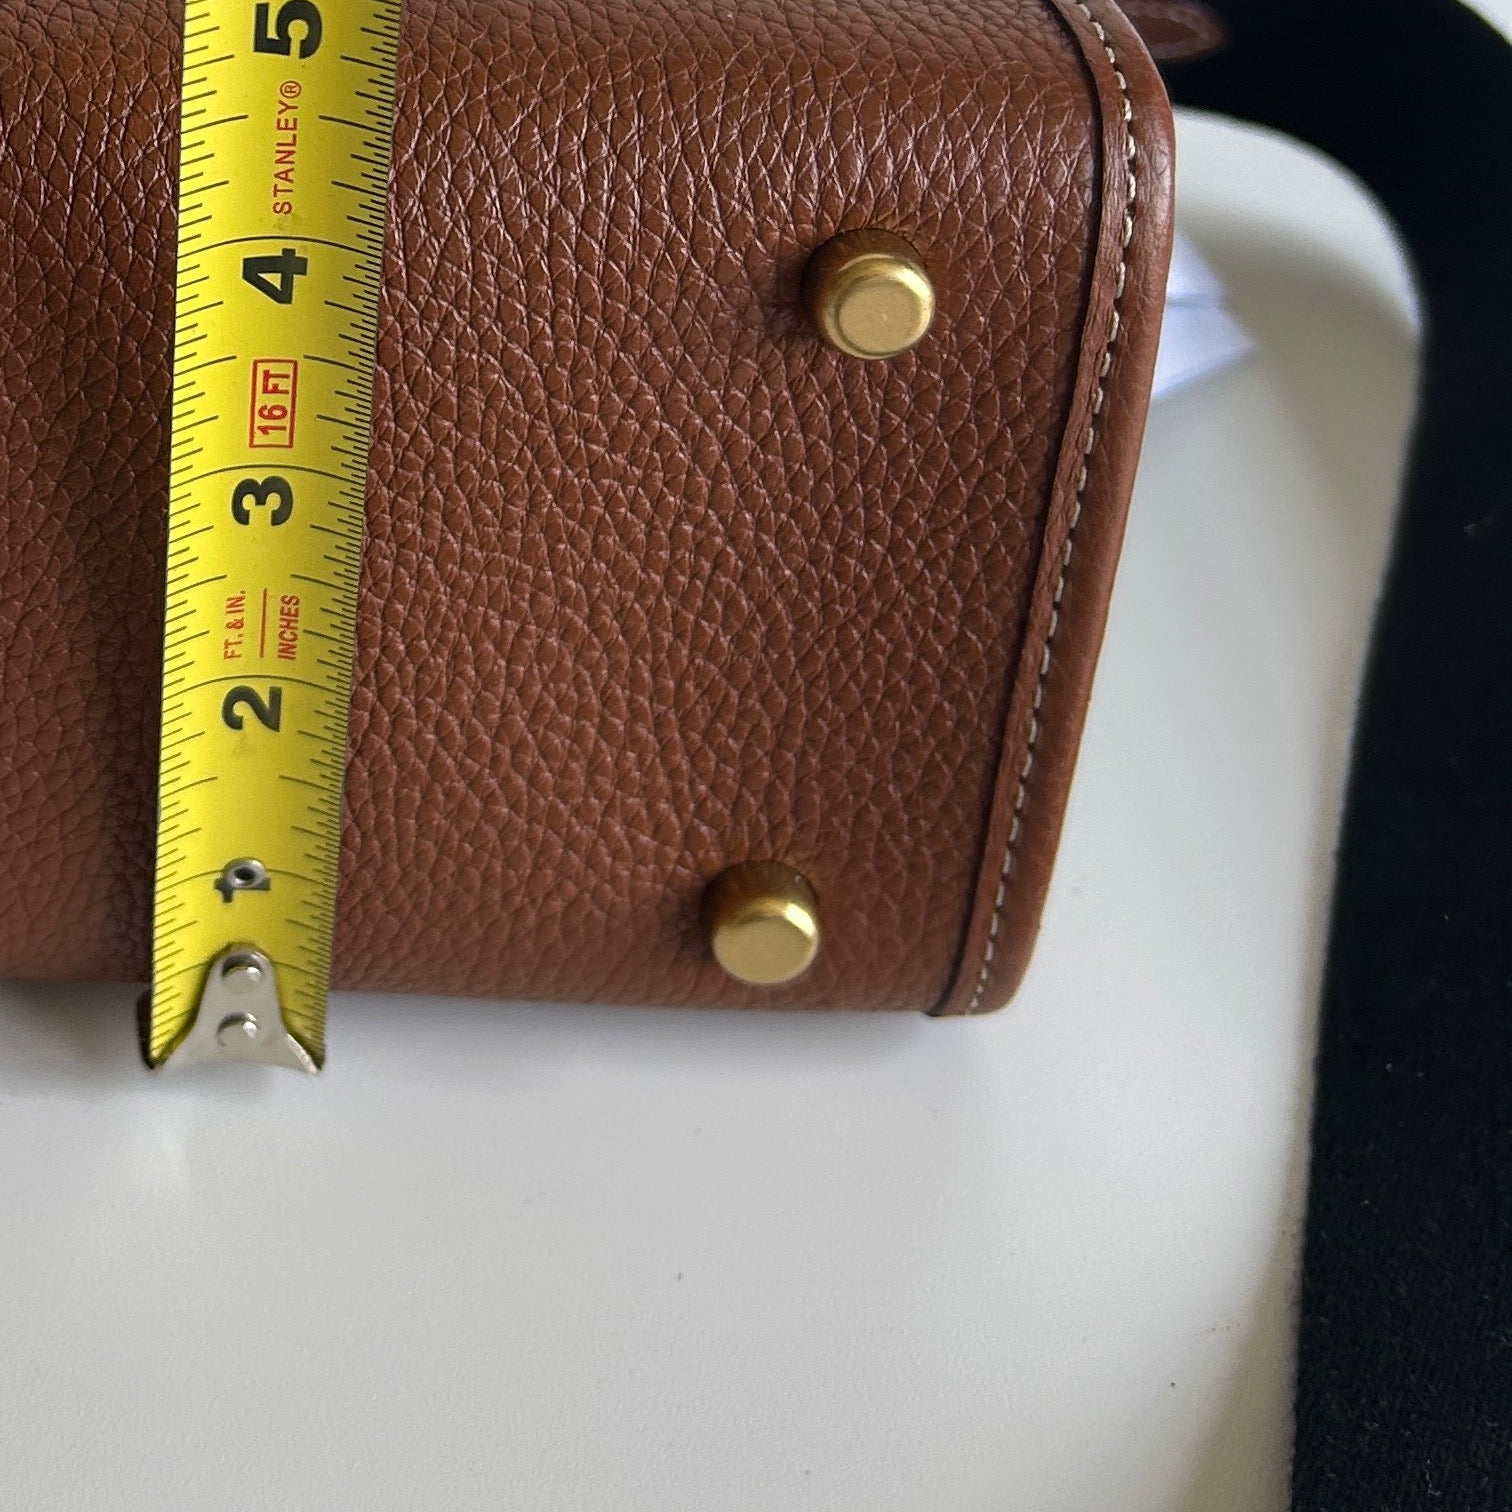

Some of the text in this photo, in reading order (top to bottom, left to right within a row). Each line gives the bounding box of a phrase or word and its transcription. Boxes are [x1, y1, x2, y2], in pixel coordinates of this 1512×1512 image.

[242, 248, 308, 305] 4
[256, 370, 291, 435] 16 FT
[231, 475, 293, 526] 3
[277, 594, 300, 660] INCHES
[221, 685, 283, 732] 2
